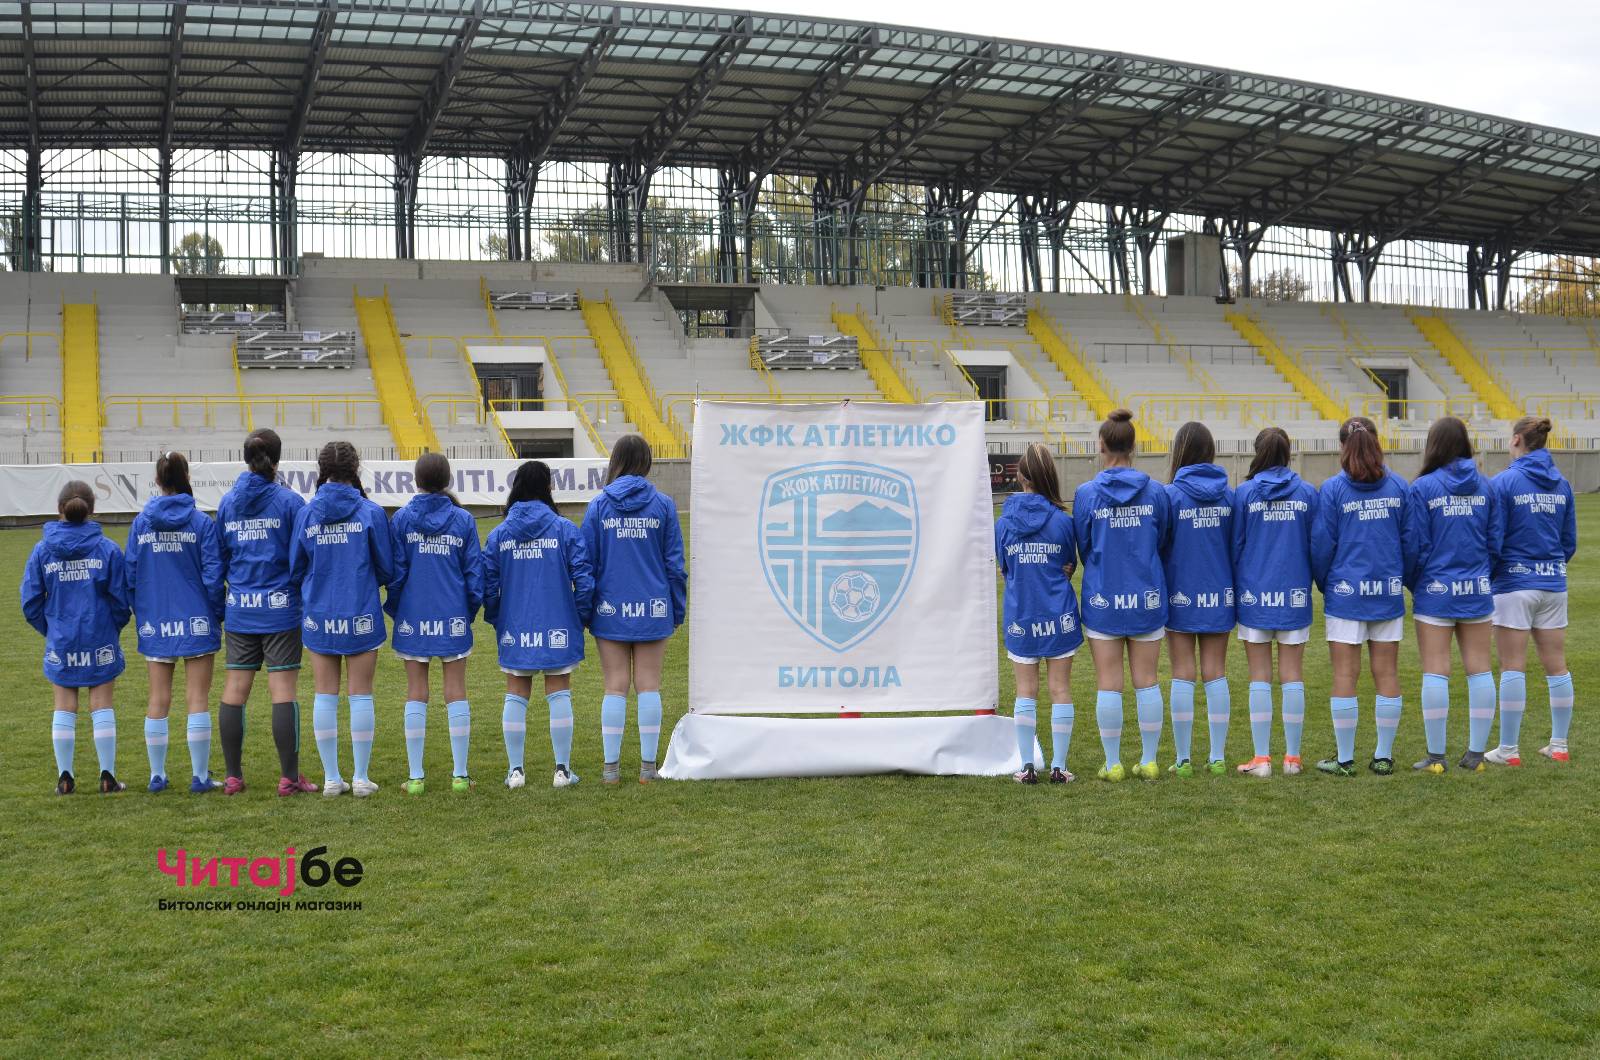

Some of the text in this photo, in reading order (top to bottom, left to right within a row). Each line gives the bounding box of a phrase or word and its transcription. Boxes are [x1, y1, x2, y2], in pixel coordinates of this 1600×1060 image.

[719, 424, 956, 447] ЖФК АТЛЕТИКО
[779, 473, 900, 499] ЖФК АТЛЕТИКО
[1094, 505, 1154, 520] ЖФК АТЛЕТИКО
[1248, 501, 1269, 513] ЖФК
[1342, 498, 1400, 514] ЖФК АТЛЕТИКО
[1442, 505, 1474, 516] БИТОЛА
[1263, 510, 1296, 522] БИТОЛА
[1358, 509, 1390, 520] БИТОЛА
[224, 518, 280, 532] ЖФК АТЛЕТИКО
[602, 517, 660, 530] ЖФК АТЛЕТИКО
[1110, 517, 1140, 528] БИТОЛА
[238, 530, 268, 541] БИТОЛА
[305, 522, 362, 540] ЖФК АТЛЕТИКО
[616, 526, 648, 539] БИТОЛА
[138, 531, 196, 545] ЖФК АТЛЕТИКО
[316, 532, 348, 545] БИТОЛА
[152, 541, 183, 552] БИТОЛА
[418, 542, 451, 556] БИТОЛА
[512, 548, 543, 560] БИТОЛА
[1018, 553, 1048, 564] БИТОЛА
[44, 558, 103, 574] ЖФК АТЛЕТИКО
[59, 570, 90, 582] БИТОЛА
[778, 666, 902, 689] БИТОЛА
